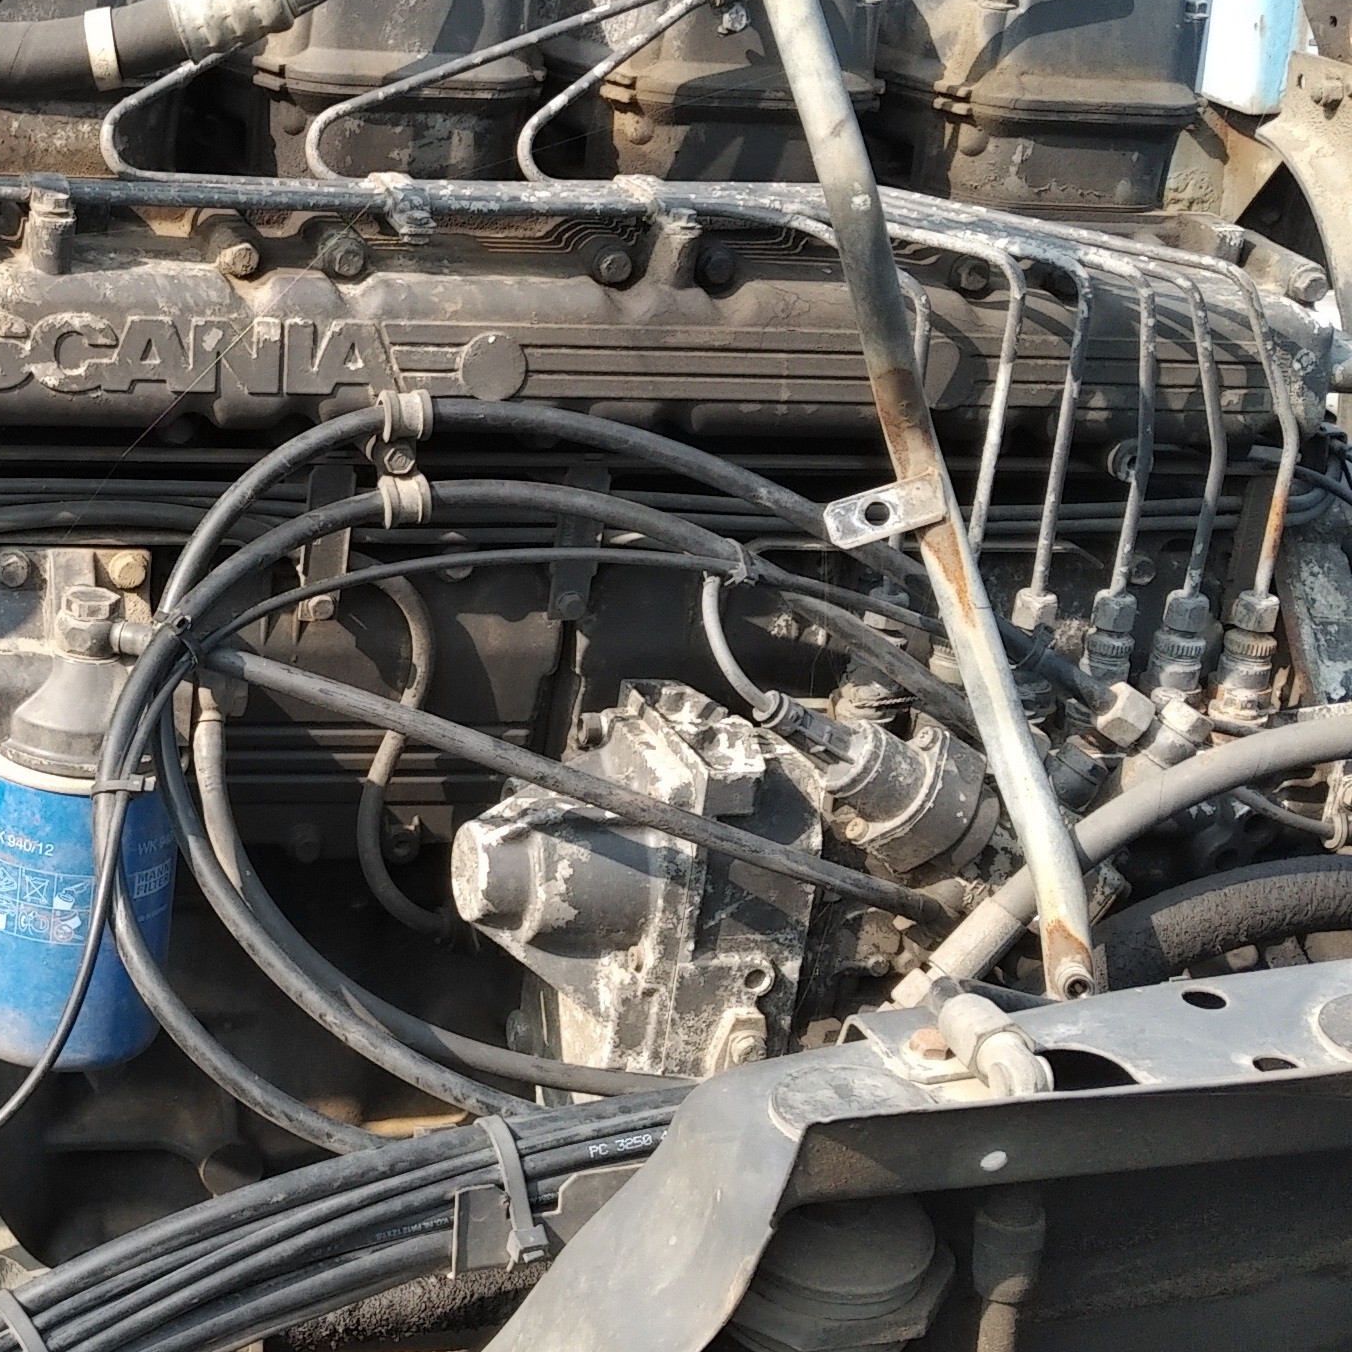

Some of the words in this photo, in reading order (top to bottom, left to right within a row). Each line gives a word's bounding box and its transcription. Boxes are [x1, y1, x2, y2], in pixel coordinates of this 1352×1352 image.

[7, 834, 55, 857] 940/12
[138, 839, 159, 855] WK
[137, 863, 170, 883] MANN
[136, 876, 168, 896] FILTER
[588, 1143, 609, 1158] PC
[615, 1133, 653, 1152] 3250
